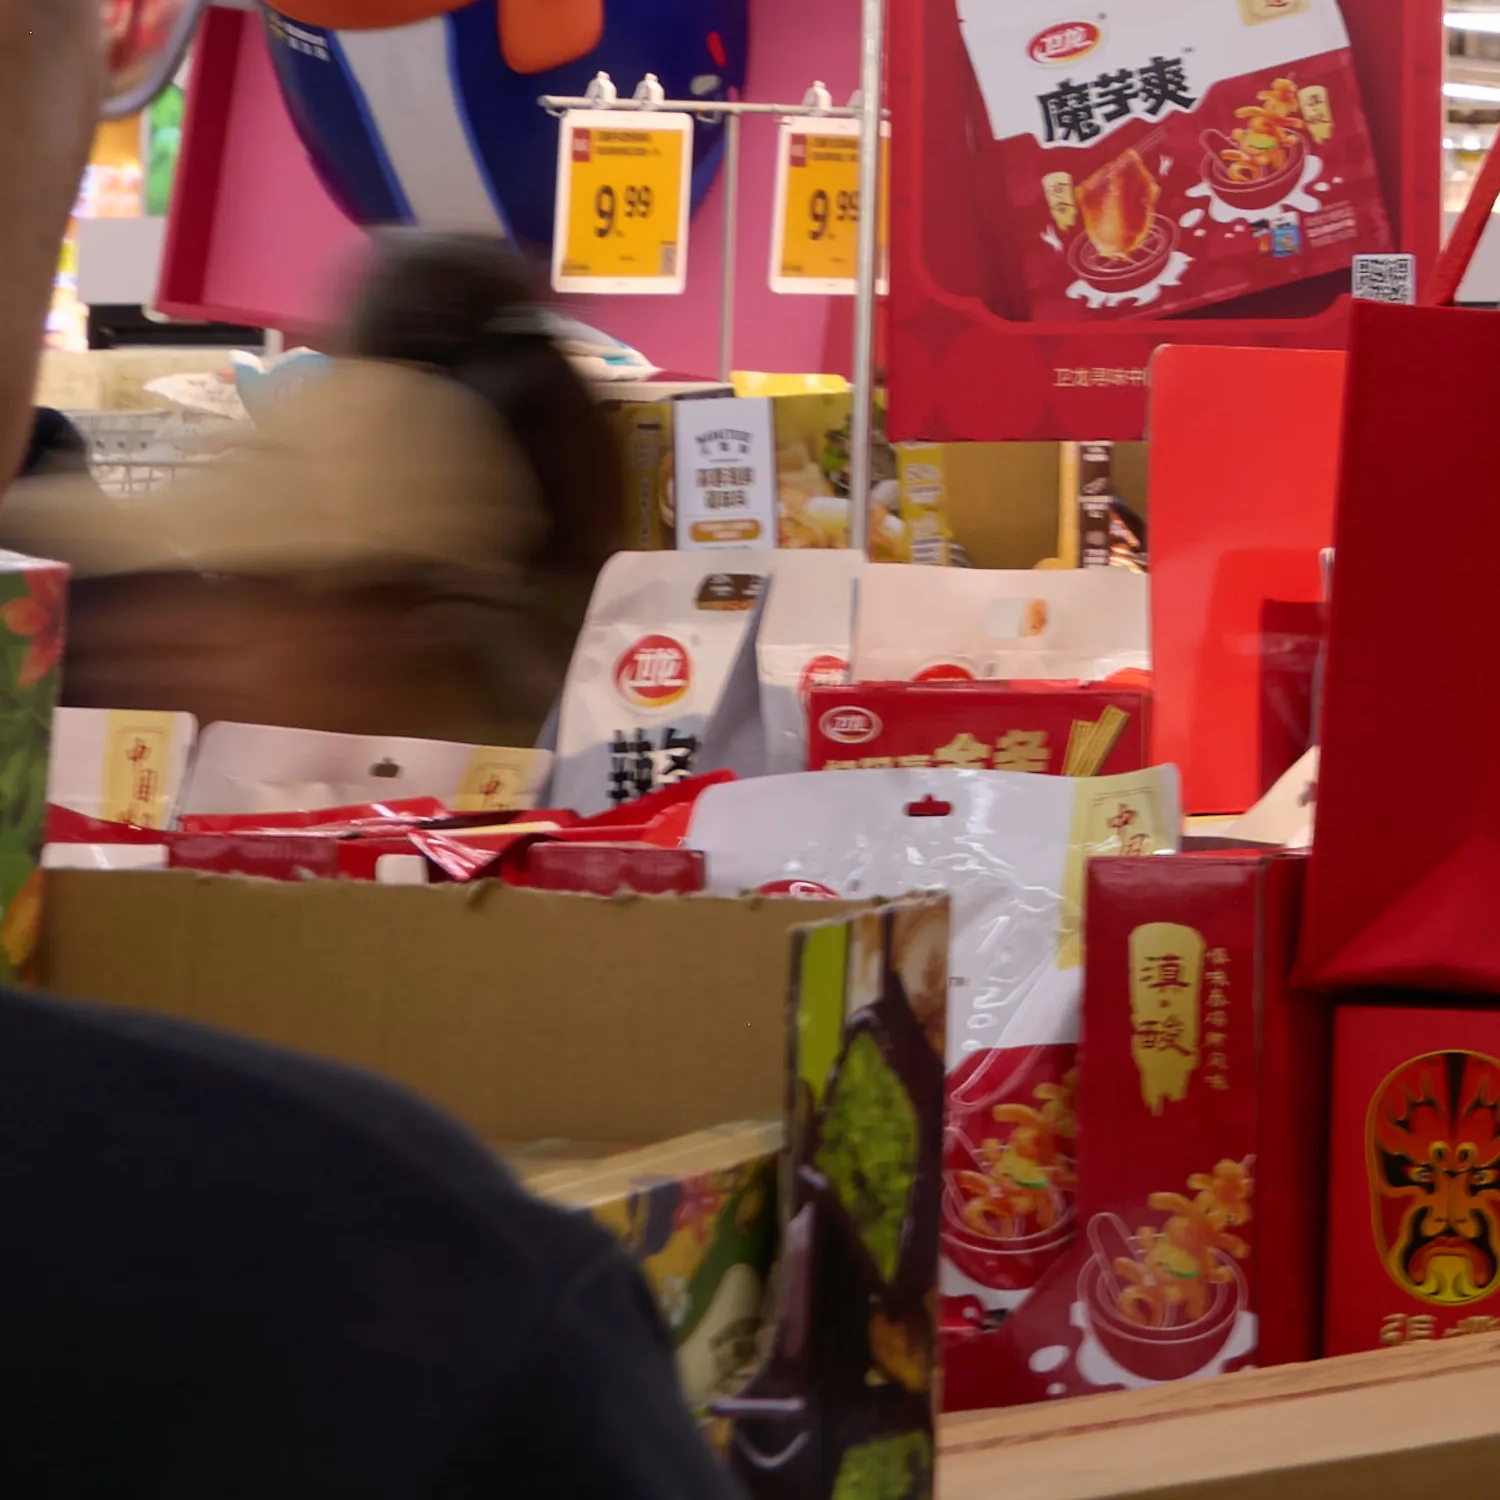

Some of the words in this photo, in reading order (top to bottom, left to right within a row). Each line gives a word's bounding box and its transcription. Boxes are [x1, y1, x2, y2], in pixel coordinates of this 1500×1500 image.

[1035, 55, 1198, 143] 魔芋爽
[1053, 367, 1150, 389] 卫龙寻味中
